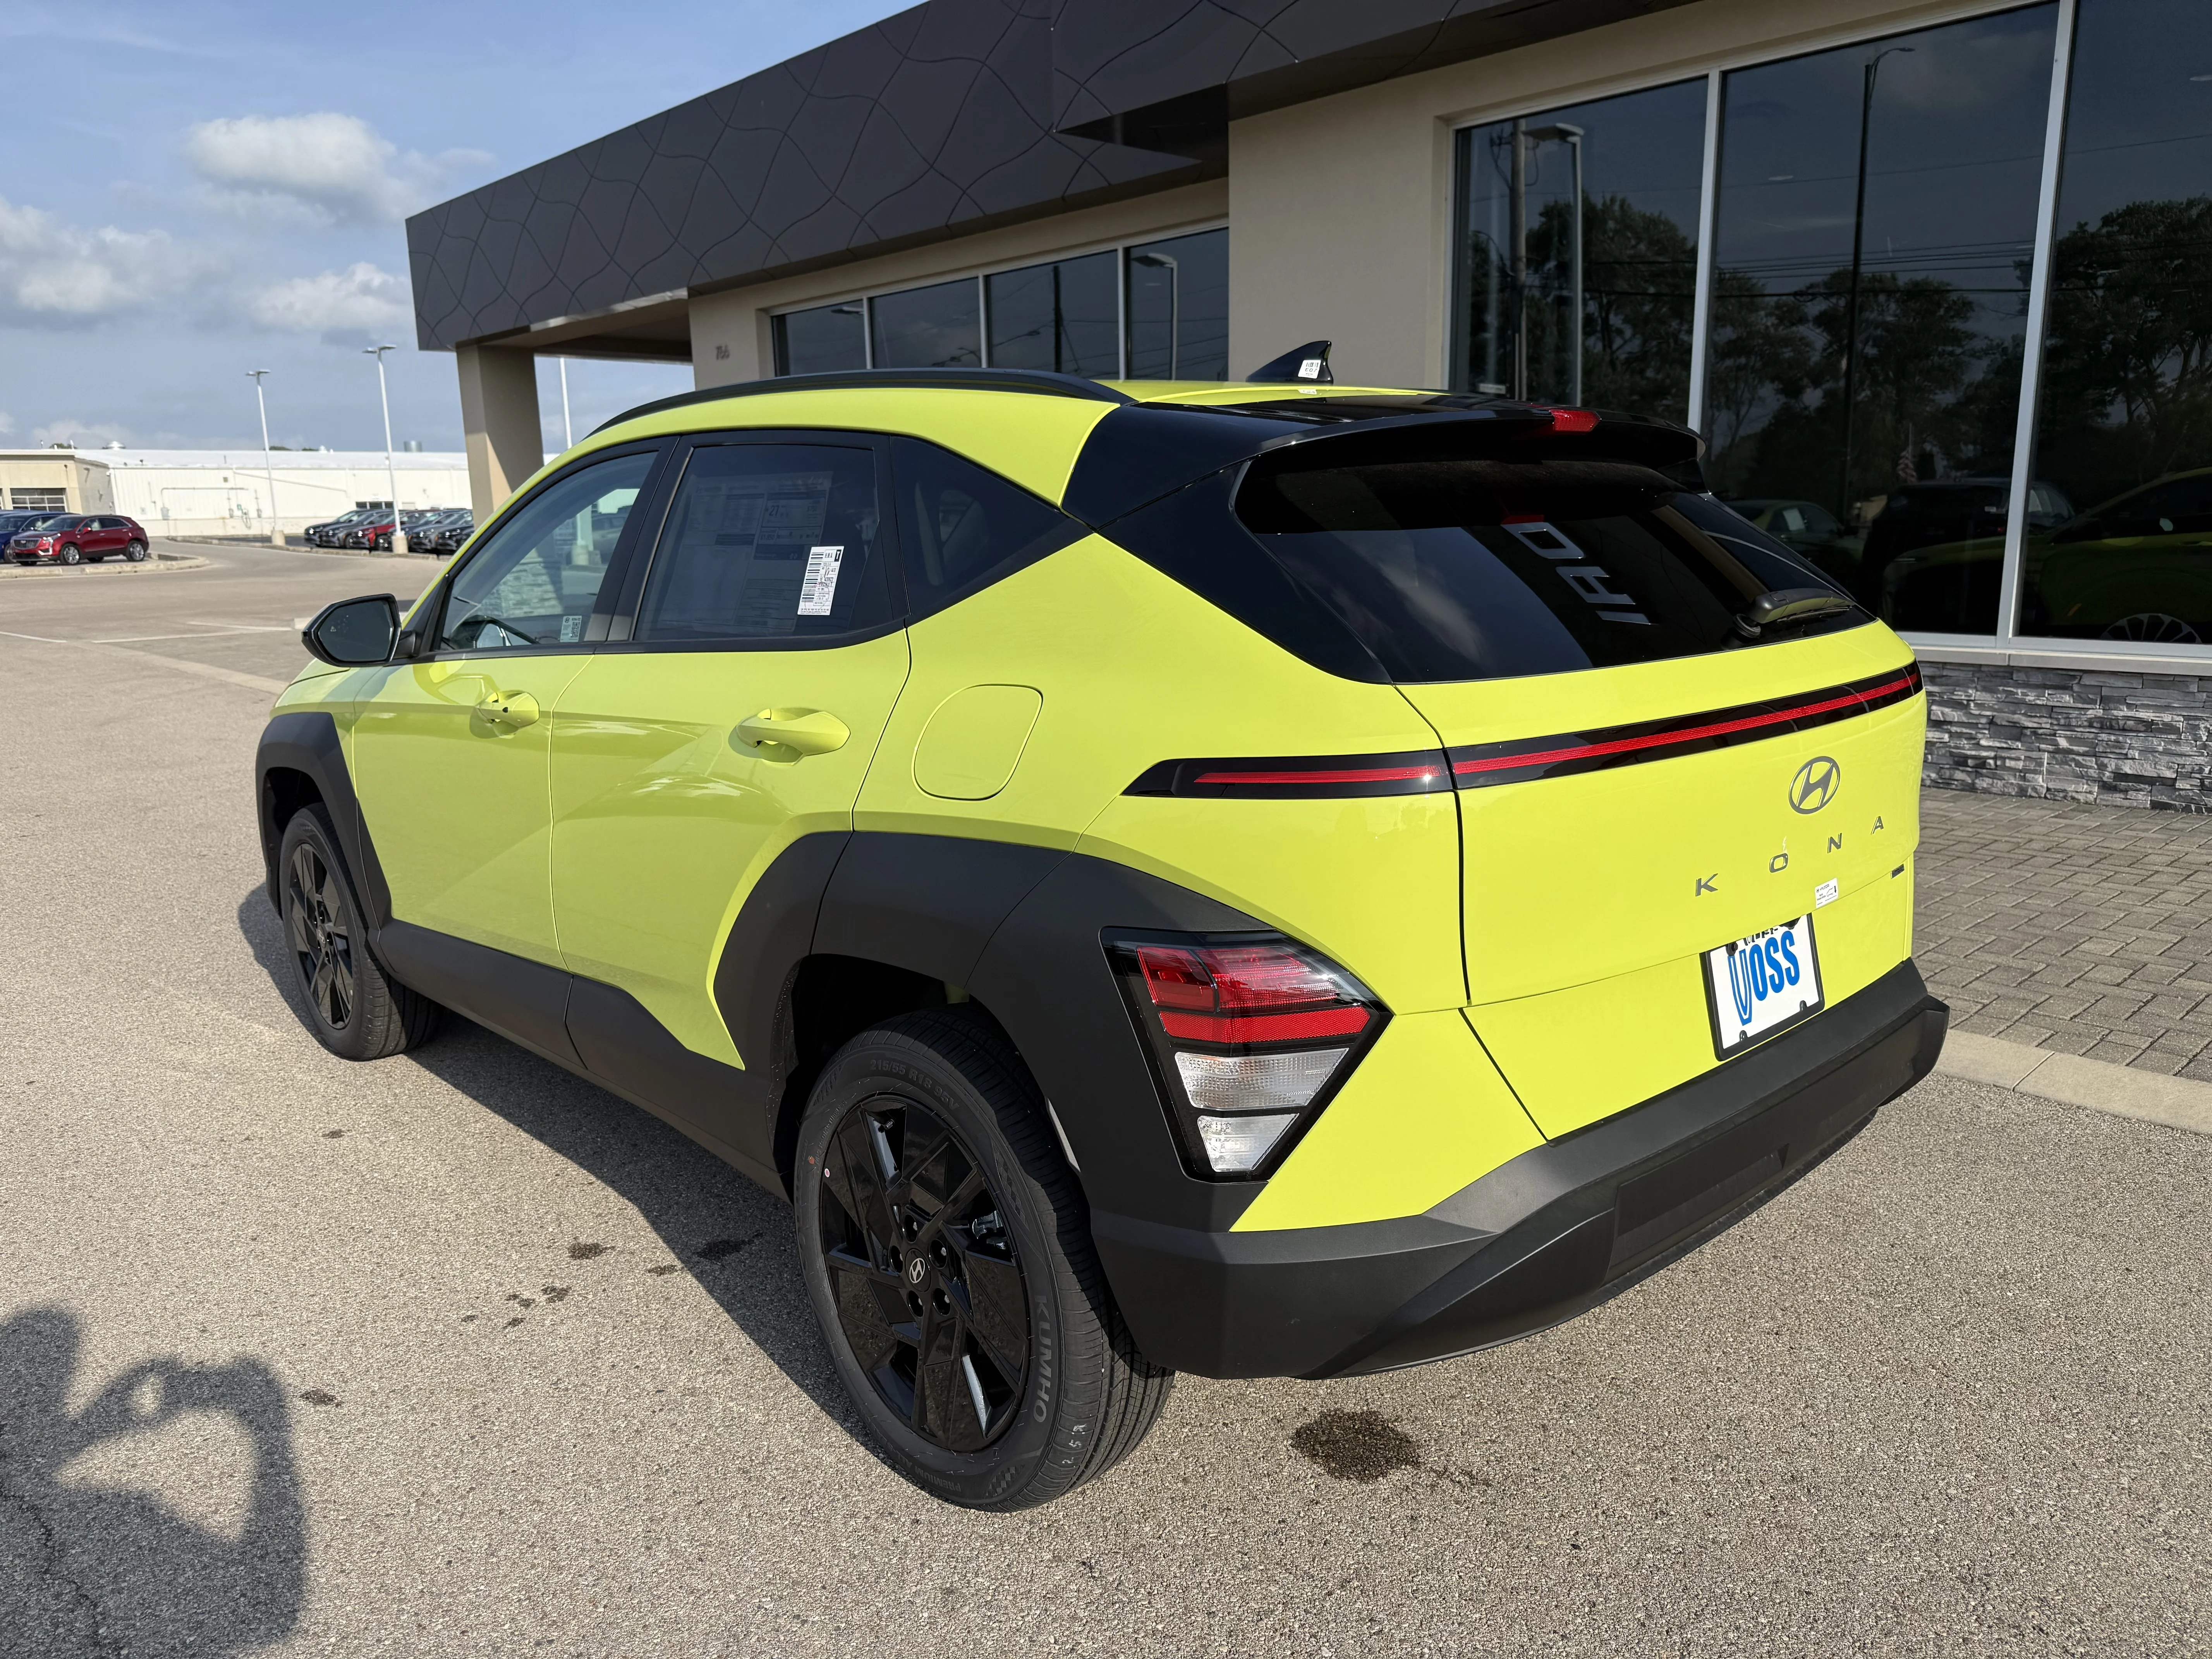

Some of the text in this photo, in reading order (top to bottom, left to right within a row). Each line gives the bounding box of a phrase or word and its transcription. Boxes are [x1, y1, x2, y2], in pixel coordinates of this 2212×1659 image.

[769, 505, 780, 516] 27
[1695, 816, 1884, 897] KONA
[1728, 930, 1800, 1026] VOSS
[869, 1059, 960, 1110] 215/55 R18 95V
[1033, 1295, 1052, 1423] KUMHO
[915, 1465, 961, 1492] PREMIUM
